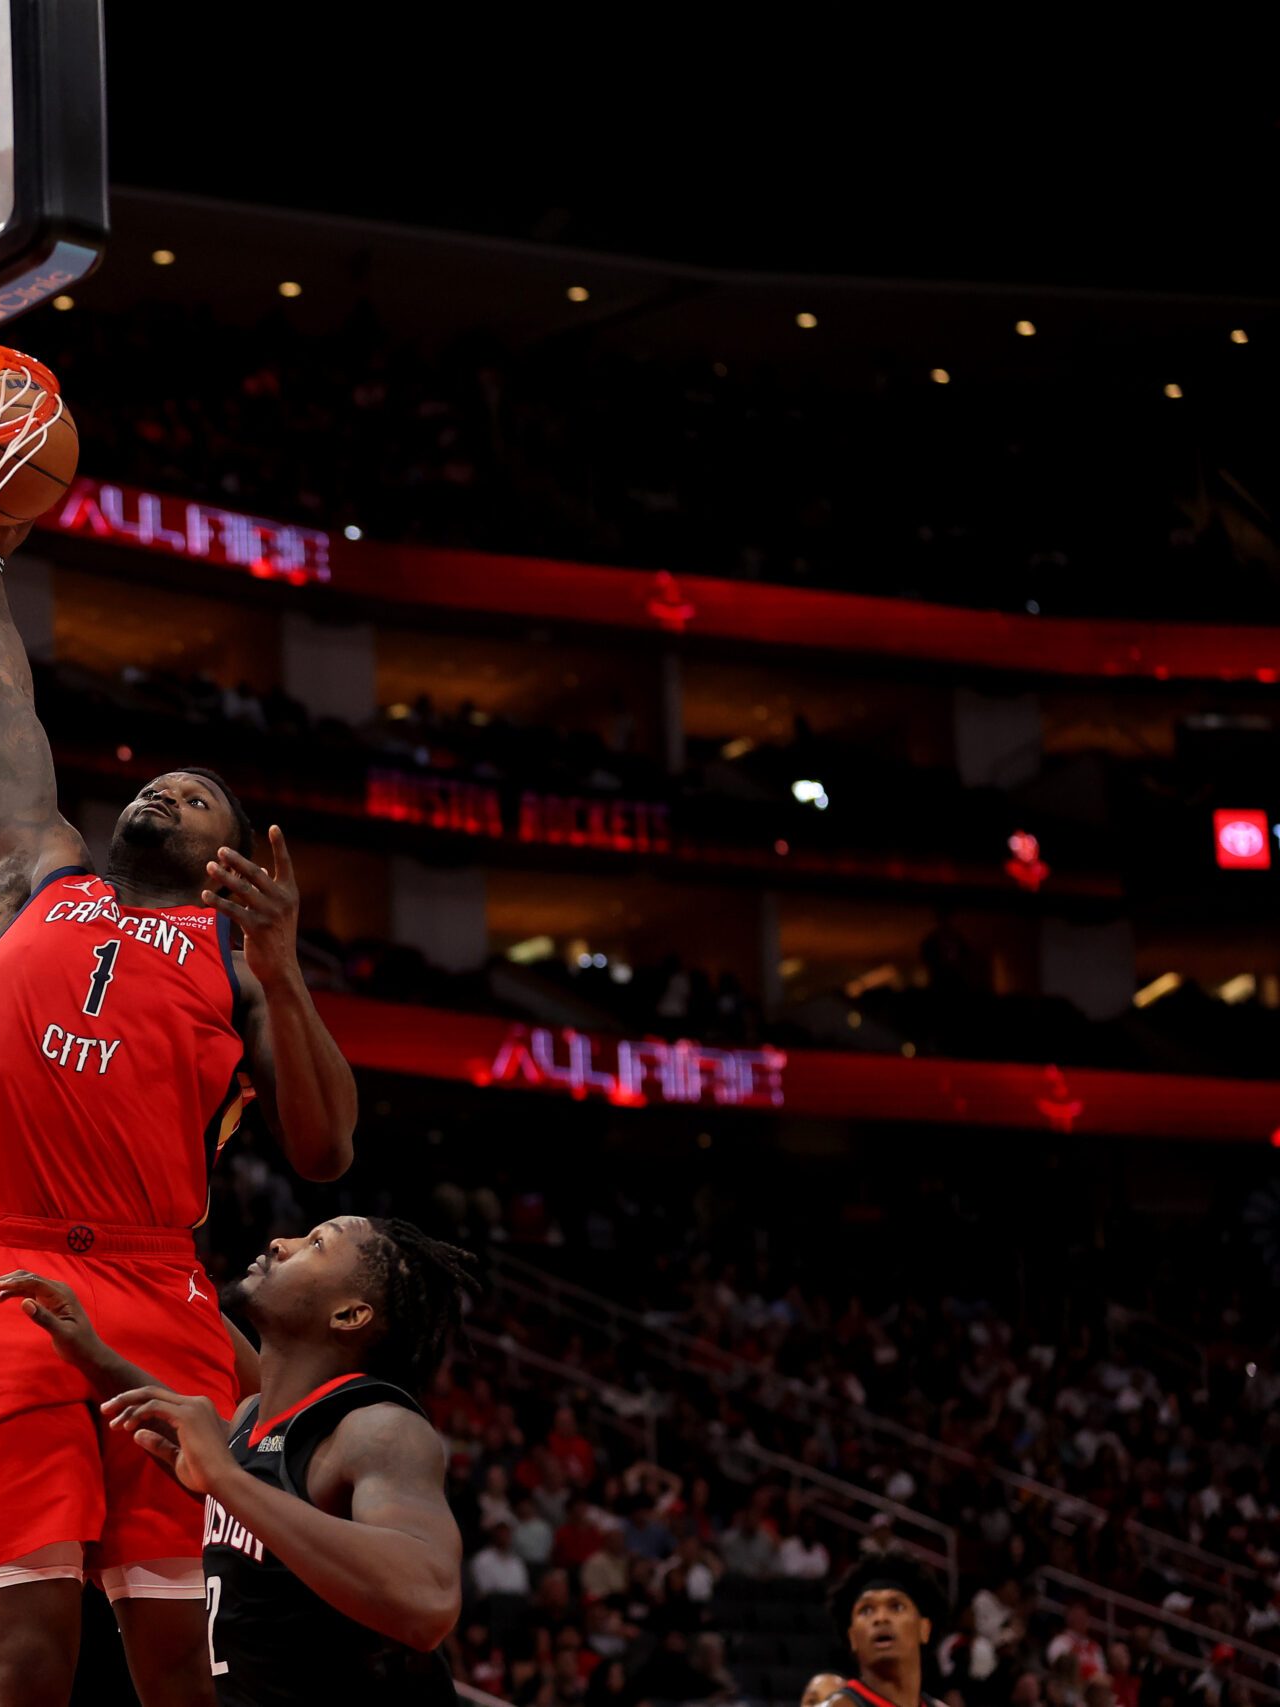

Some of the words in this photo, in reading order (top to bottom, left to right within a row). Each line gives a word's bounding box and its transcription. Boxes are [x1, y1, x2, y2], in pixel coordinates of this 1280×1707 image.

[43, 895, 195, 966] CRESCENT
[160, 912, 215, 926] NEWAGE
[82, 939, 121, 1017] 1
[41, 1023, 121, 1075] CITY
